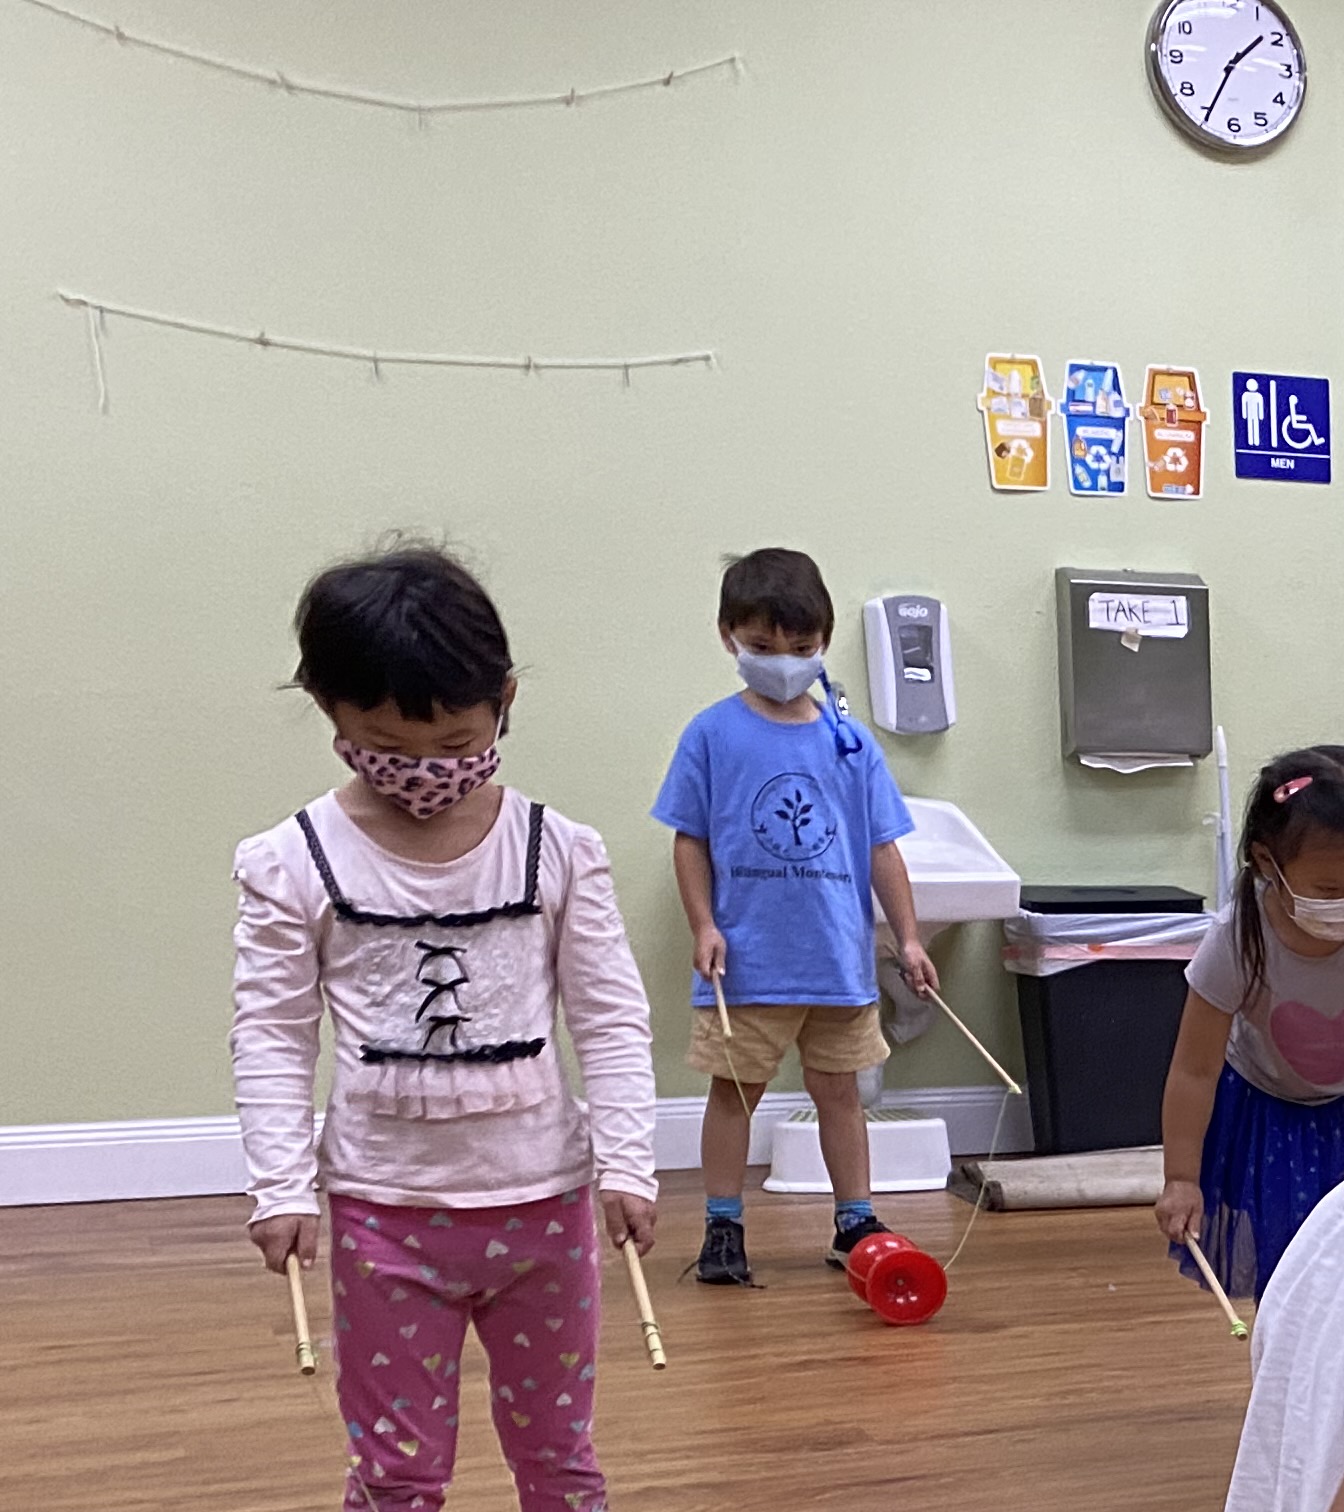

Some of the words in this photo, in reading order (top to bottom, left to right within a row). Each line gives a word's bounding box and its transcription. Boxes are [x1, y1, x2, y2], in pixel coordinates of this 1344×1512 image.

[1178, 20, 1192, 35] 10
[1270, 32, 1284, 47] 2
[1169, 50, 1184, 64] 9
[1278, 63, 1293, 79] 3
[1179, 81, 1195, 97] 8
[1272, 92, 1286, 107] 4
[1227, 118, 1241, 133] 6
[1253, 112, 1268, 127] 5
[1270, 457, 1295, 470] MEN
[1098, 598, 1152, 625] TAKE
[1166, 600, 1186, 626] 1
